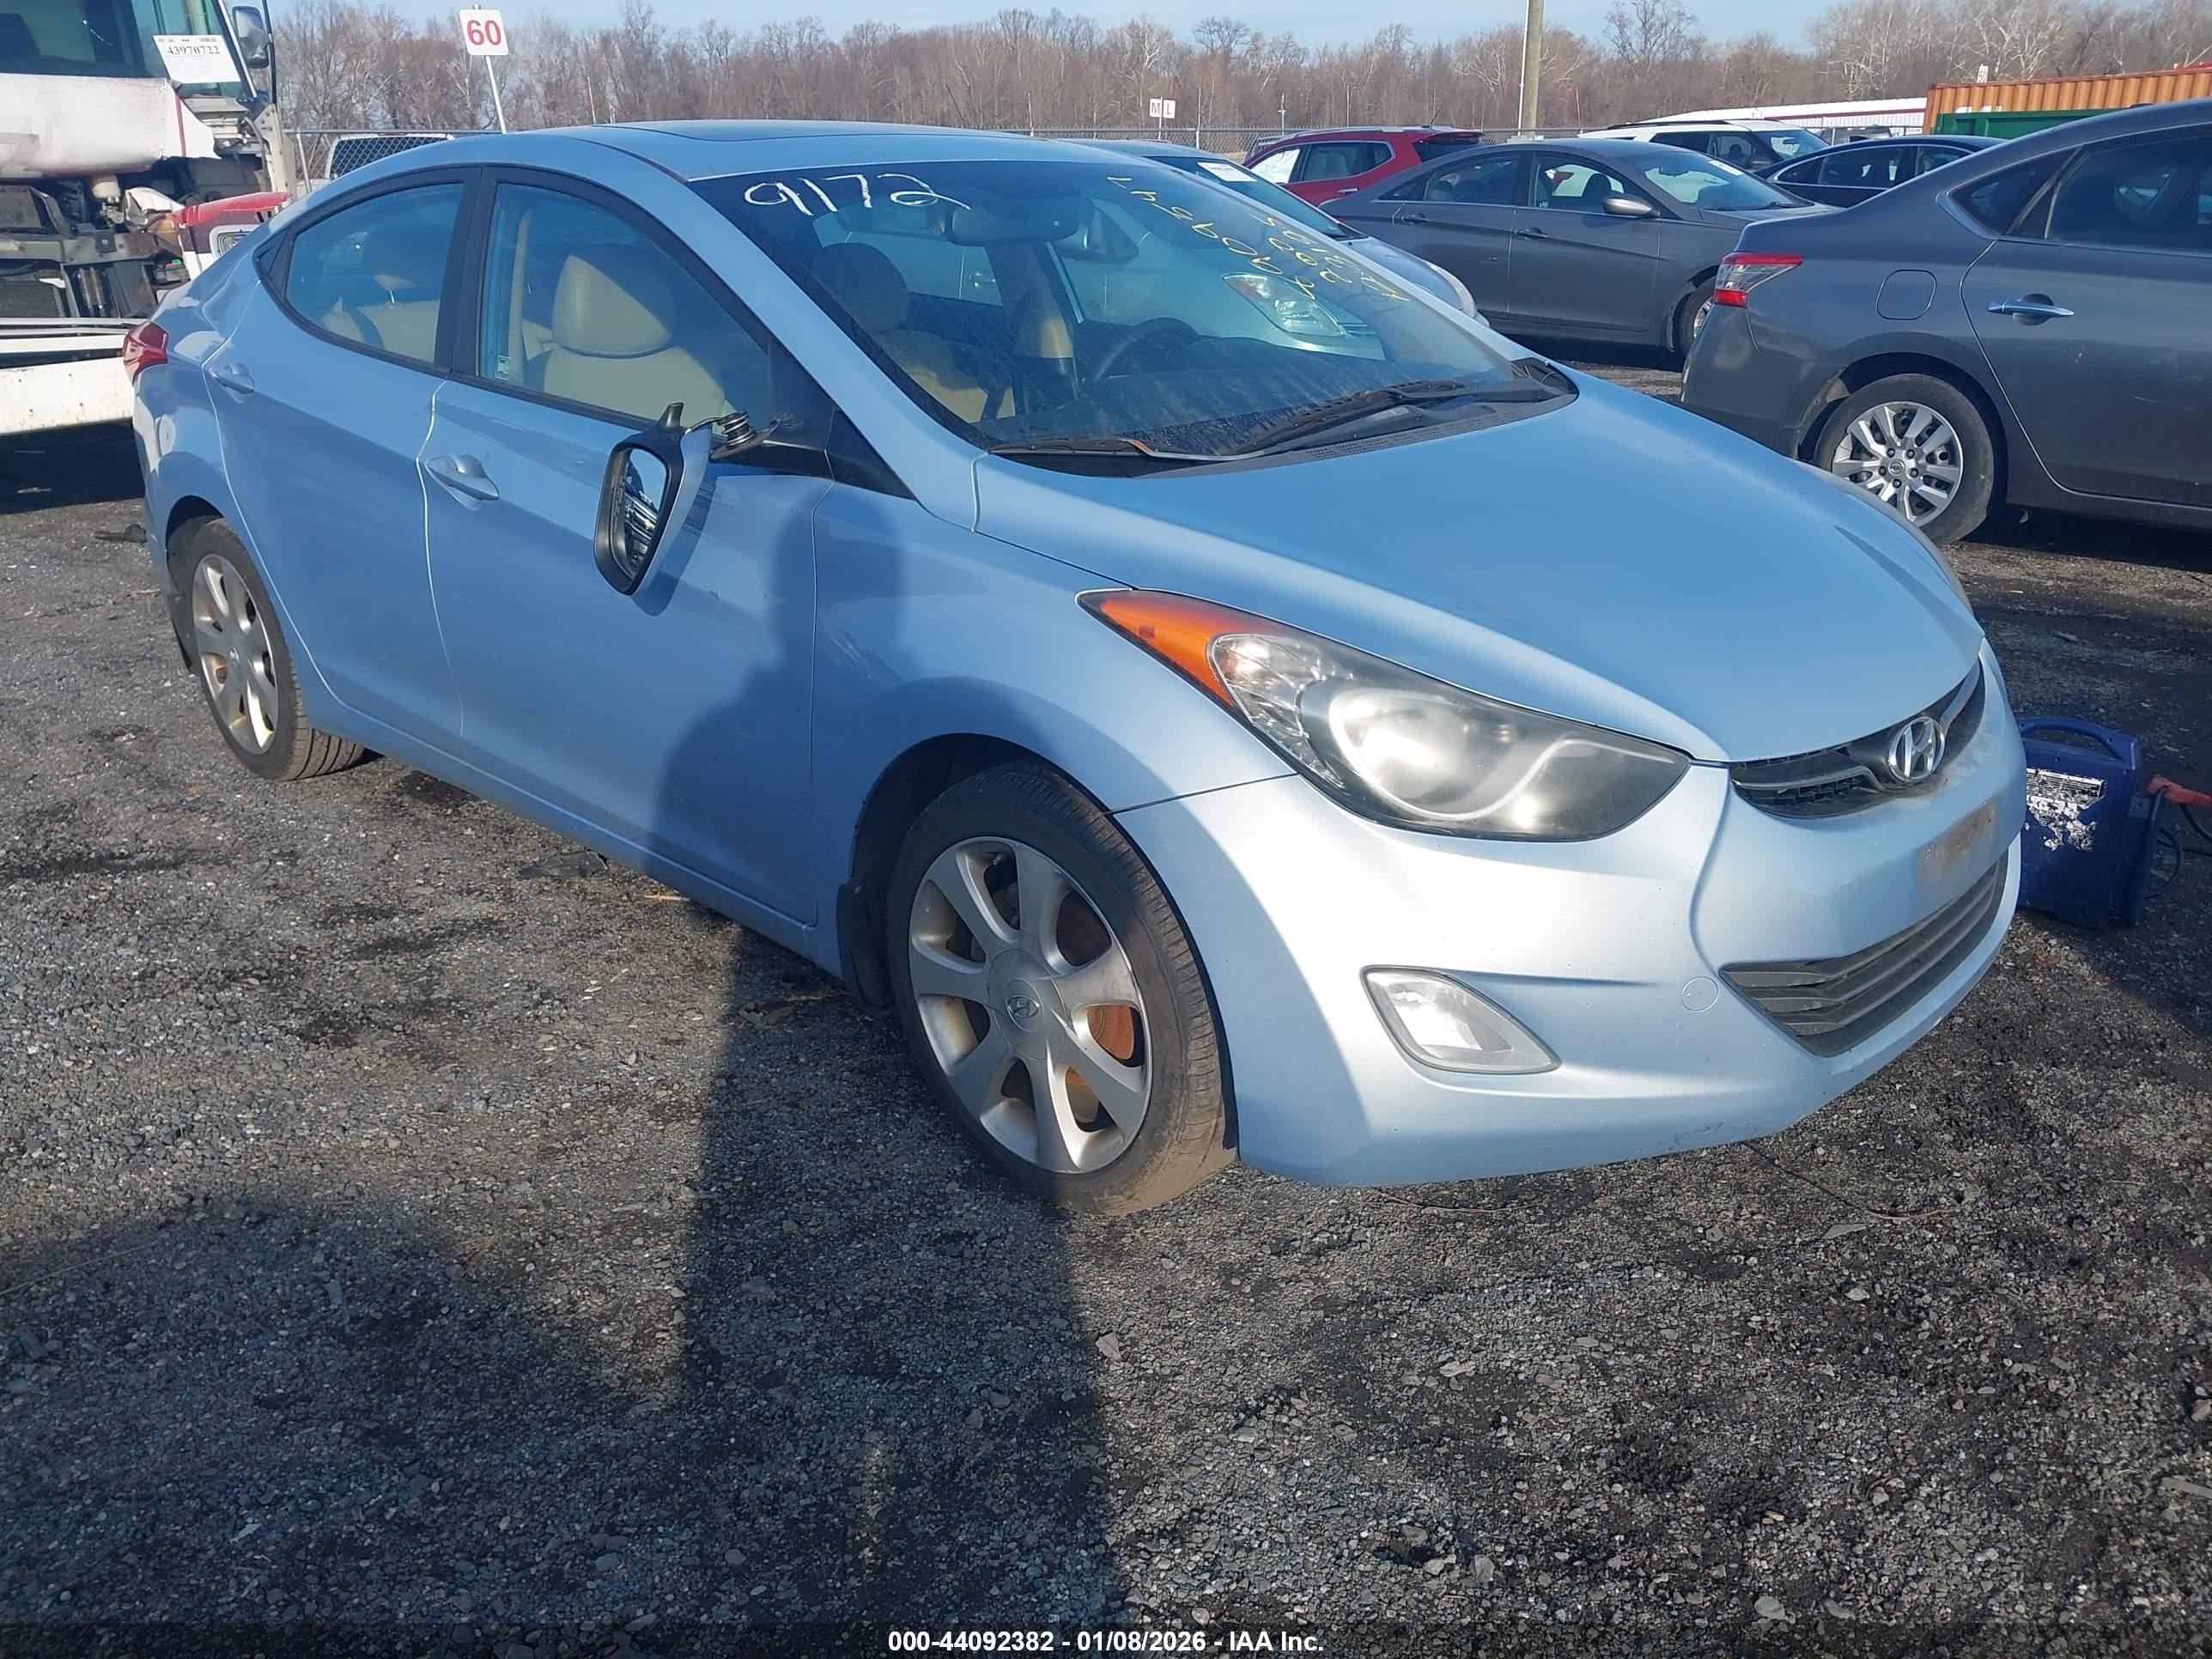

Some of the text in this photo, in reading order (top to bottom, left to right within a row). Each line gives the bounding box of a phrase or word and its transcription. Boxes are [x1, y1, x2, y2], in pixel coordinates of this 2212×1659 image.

[466, 19, 501, 46] 60
[167, 46, 220, 55] 43970722
[744, 173, 971, 216] 9172
